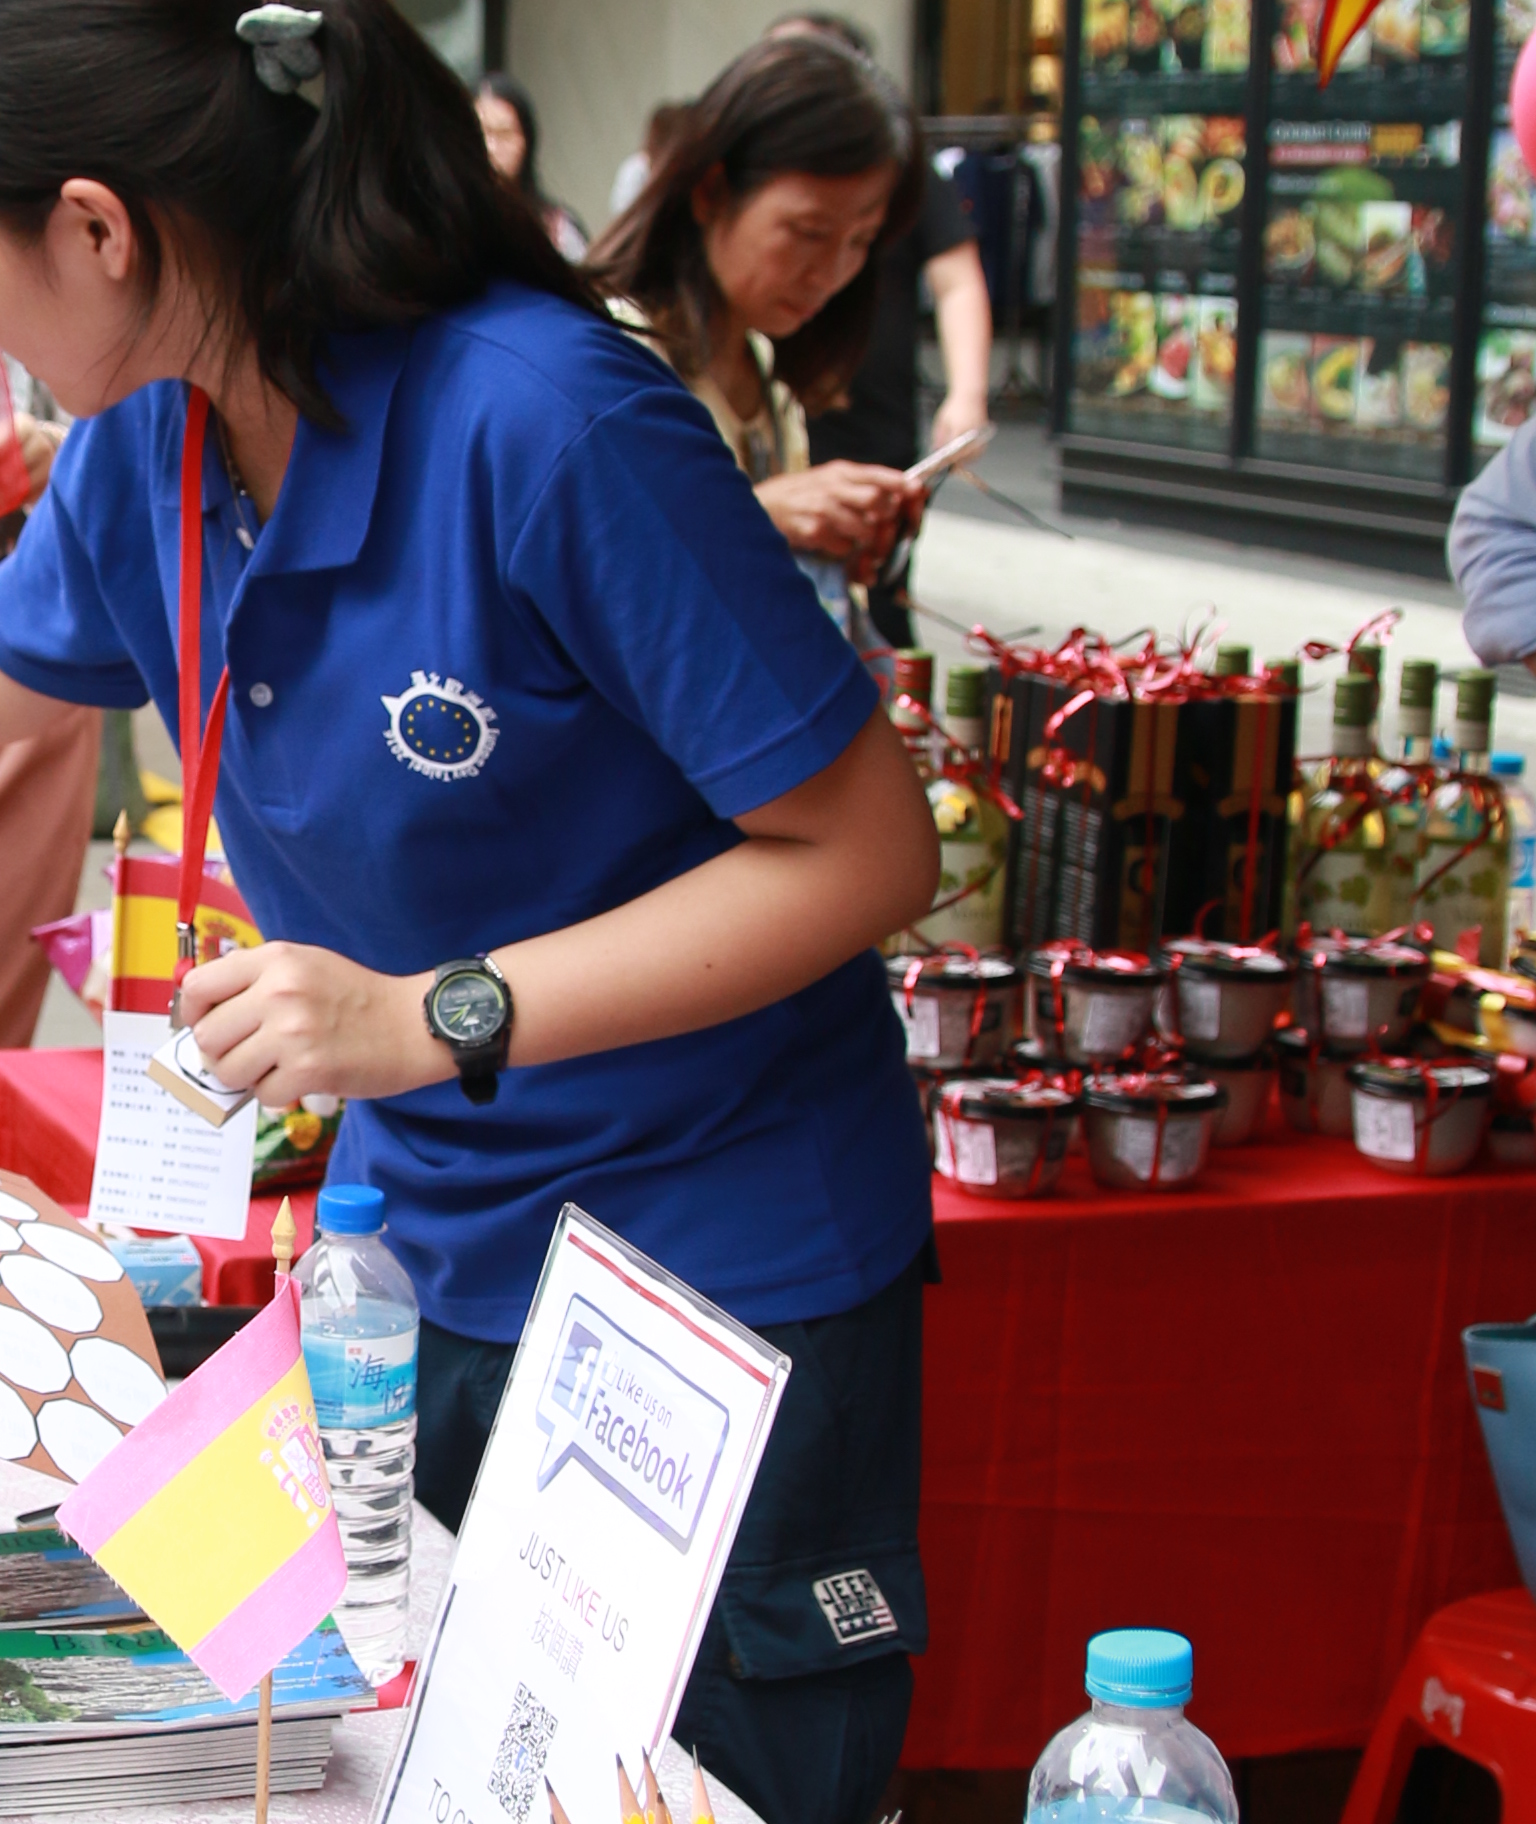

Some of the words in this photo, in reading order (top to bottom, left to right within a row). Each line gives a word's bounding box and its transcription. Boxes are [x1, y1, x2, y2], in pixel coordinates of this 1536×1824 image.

[350, 1353, 412, 1416] 海悅
[616, 1367, 644, 1405] Like
[643, 1393, 659, 1416] us
[656, 1406, 673, 1430] on
[585, 1386, 694, 1511] Facebook
[519, 1531, 566, 1589] JUST
[562, 1567, 602, 1628] LIKE
[601, 1604, 629, 1653] US
[51, 1629, 168, 1652] Barcel
[530, 1602, 585, 1683] 按個讚
[428, 1777, 452, 1824] TO
